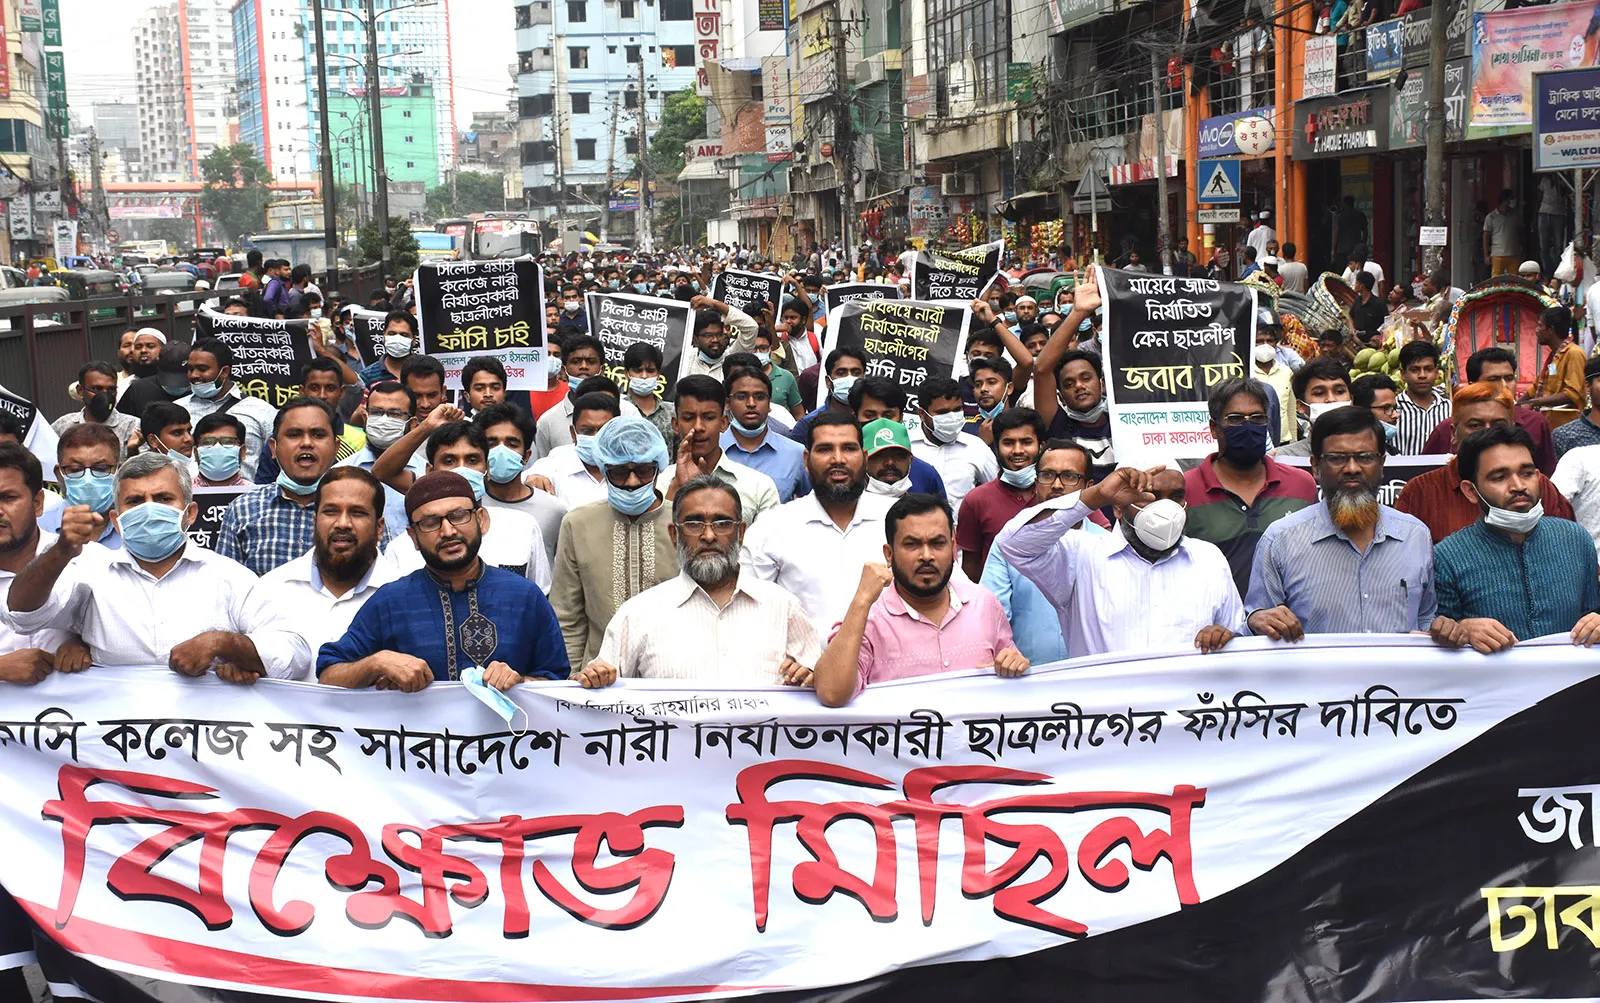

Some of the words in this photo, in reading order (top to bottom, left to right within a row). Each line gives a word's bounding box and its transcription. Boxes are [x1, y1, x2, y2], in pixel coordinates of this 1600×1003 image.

[771, 61, 780, 105] SINGER
[1548, 88, 1581, 105] ট্রাফিক
[769, 105, 785, 113] Pro
[1555, 108, 1579, 121] মেনে
[1199, 125, 1219, 143] vivo
[697, 145, 723, 157] AMZ
[1561, 147, 1600, 156] WALTO
[439, 277, 488, 293] কলেজে
[491, 272, 519, 287] নারী
[929, 284, 952, 299] দিতে
[955, 286, 979, 299] হবে
[1128, 278, 1177, 296] মায়ের
[441, 286, 519, 310] নির্যাতনকারী
[450, 304, 513, 325] ছাত্রলীগের
[601, 300, 635, 317] সিলেট
[638, 306, 668, 323] এমসি
[915, 307, 945, 324] নারী
[1145, 299, 1213, 321] নির্যাতিত
[437, 325, 488, 351] ফাঁসি
[494, 321, 530, 347] চাই
[600, 316, 642, 333] কলেজে
[644, 323, 668, 339] নারী
[860, 314, 940, 344] নির্যাতনকারী
[1132, 330, 1169, 349] কেন
[1173, 322, 1237, 350] ছাত্রলীগ
[215, 332, 263, 344] কলেজে
[265, 331, 292, 345] নারী
[508, 350, 540, 363] ইসলামী
[864, 337, 929, 361] ছাত্রলীগের
[231, 361, 290, 378] ছাত্রলীগের
[899, 367, 928, 387] চাই
[1120, 365, 1194, 395] জবাব
[1119, 411, 1168, 426] বাংলাদেশ
[1142, 432, 1167, 446] ঢাকা
[97, 719, 254, 762] কলেজ
[265, 723, 344, 775] সহ
[354, 724, 571, 776] সারাদেশে
[580, 716, 678, 767] নারী
[690, 709, 952, 760] নির্যাতনকারী
[964, 702, 1166, 761] ছাত্রলীগের
[1178, 690, 1308, 741] ফাঁসির
[1320, 684, 1468, 738] দাবিতে
[42, 764, 686, 939] বিক্ষোভ
[725, 759, 1207, 938] মিছিল
